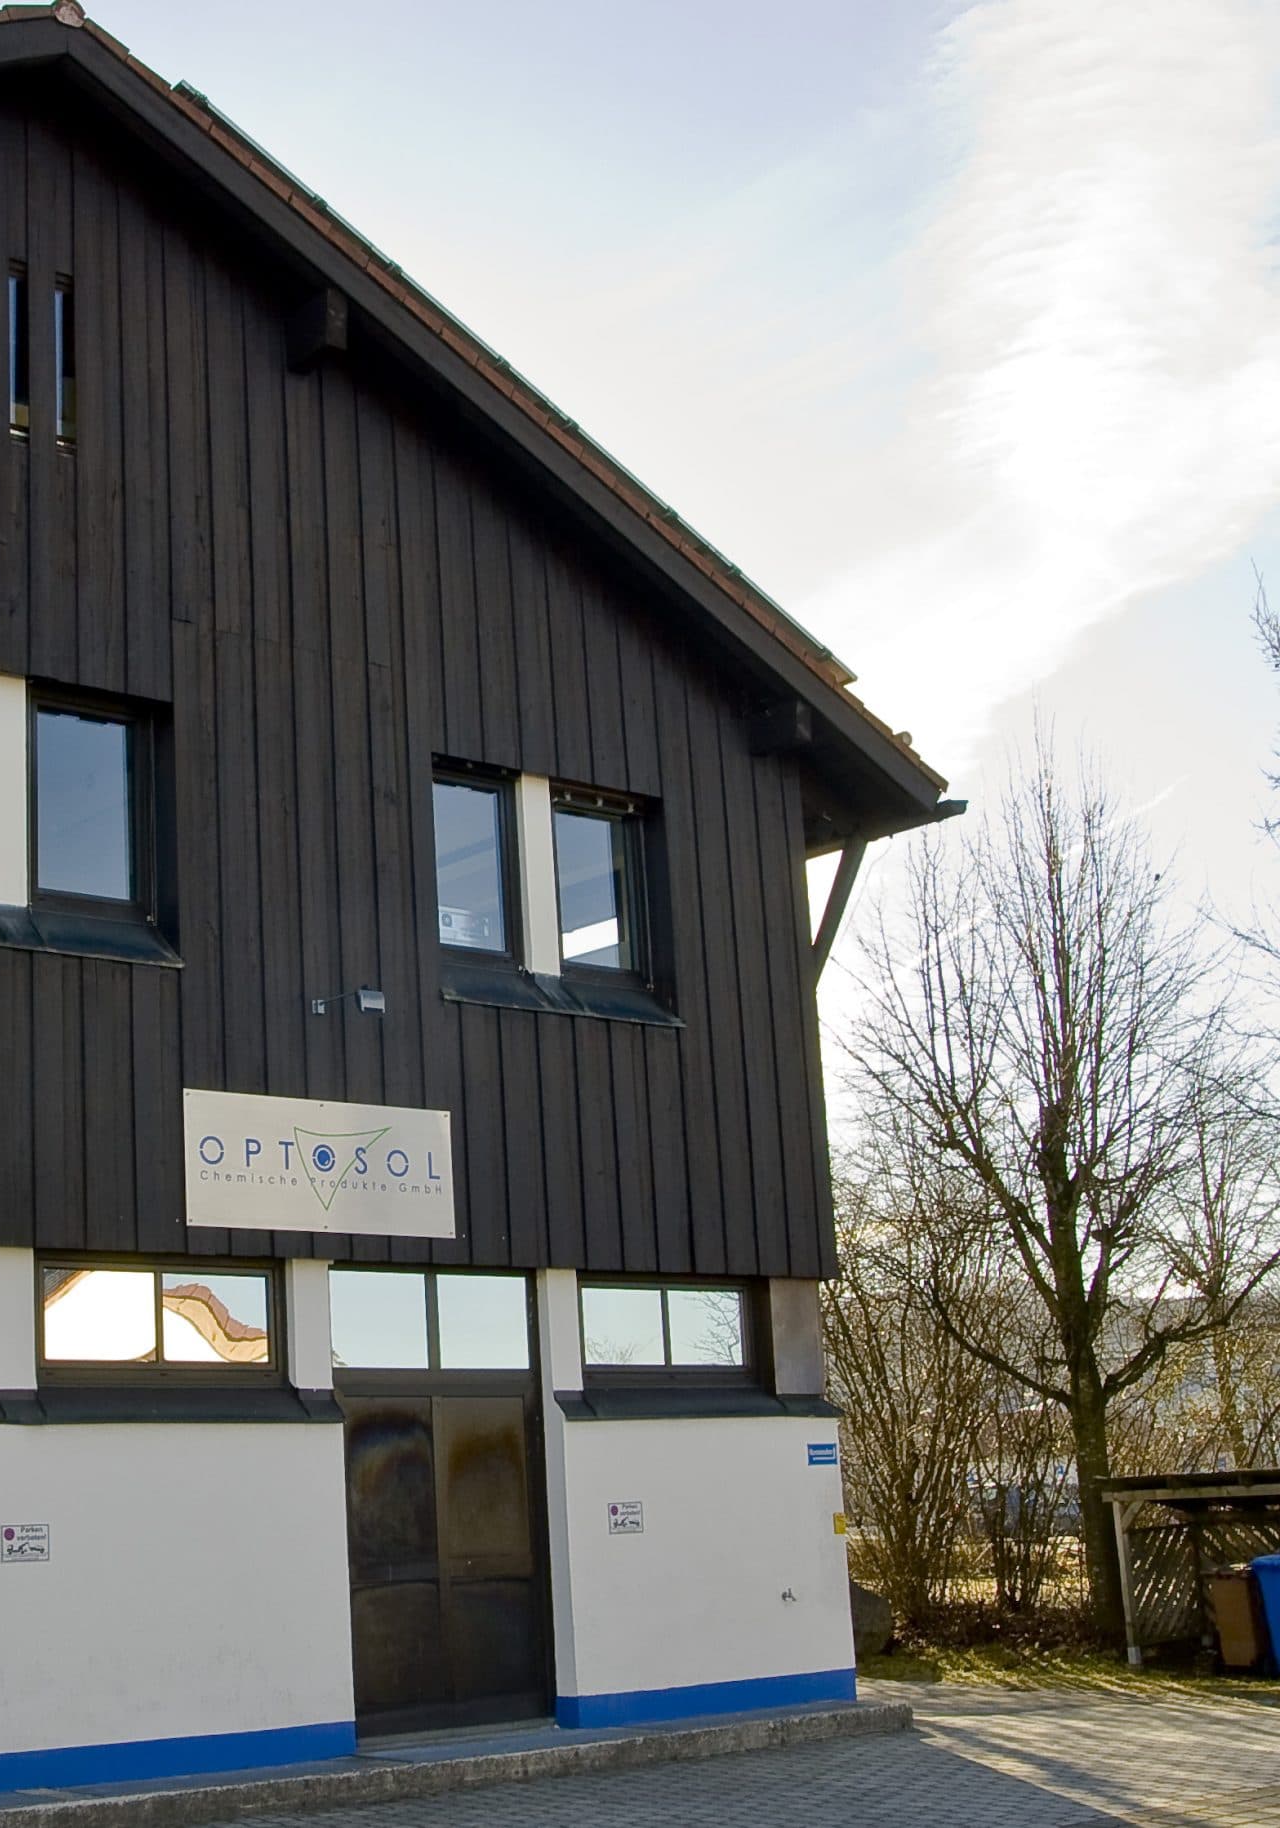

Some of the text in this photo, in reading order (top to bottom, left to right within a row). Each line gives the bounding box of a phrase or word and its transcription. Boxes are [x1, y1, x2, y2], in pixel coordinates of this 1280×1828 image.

[199, 1135, 441, 1181] OPTOSOL
[199, 1169, 443, 1195] Chemische Produkte GmbH
